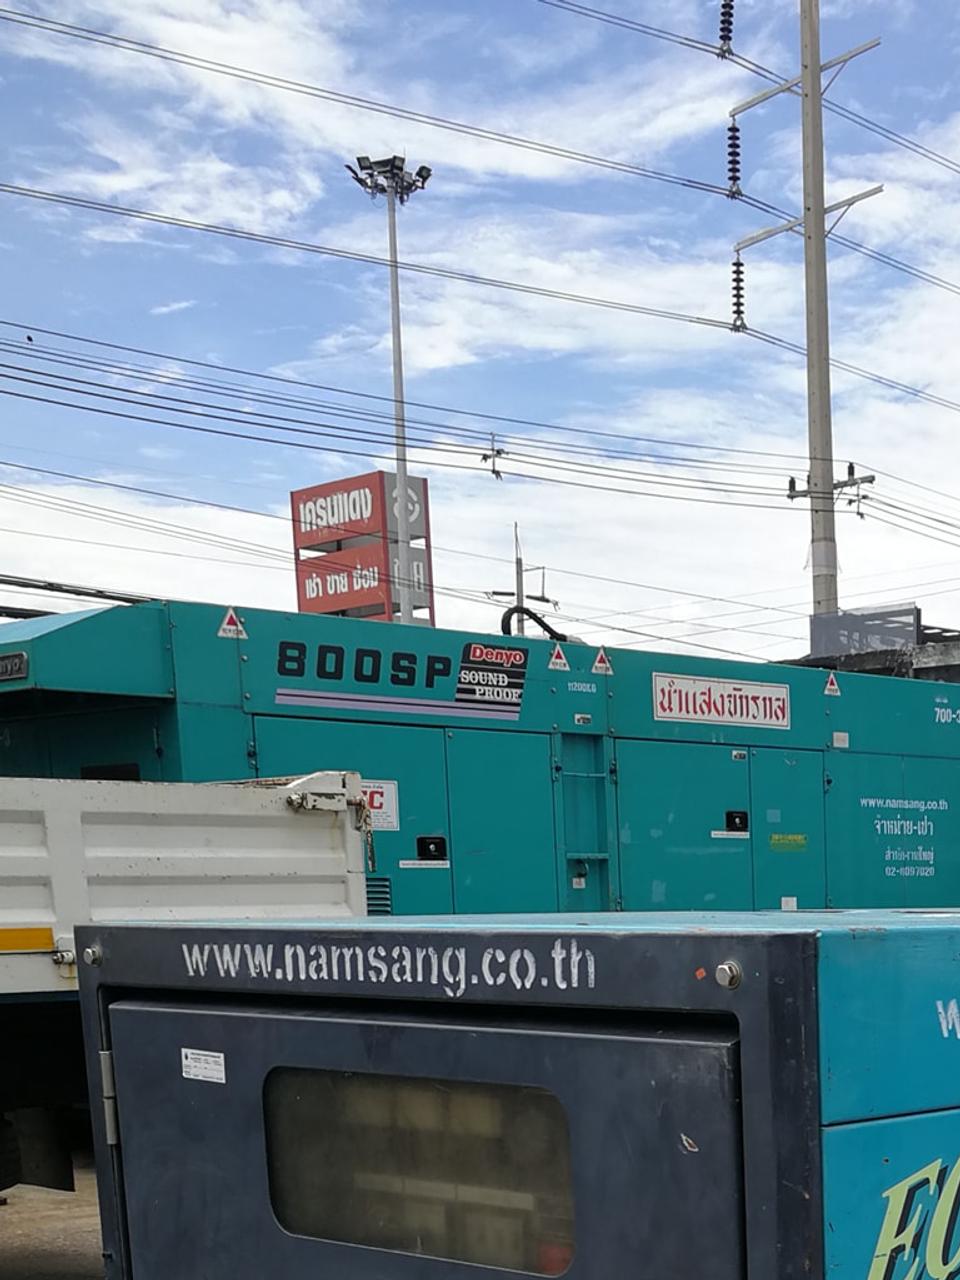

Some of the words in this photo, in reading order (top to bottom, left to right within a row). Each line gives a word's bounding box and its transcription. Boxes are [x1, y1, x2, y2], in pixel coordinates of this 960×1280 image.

[277, 640, 452, 688] 800SP
[470, 643, 525, 667] Denyo
[459, 669, 509, 687] SOUND
[475, 688, 522, 702] PROOF
[859, 797, 949, 812] www.namsang.co.th
[181, 938, 596, 998] www.namsang.co.th
